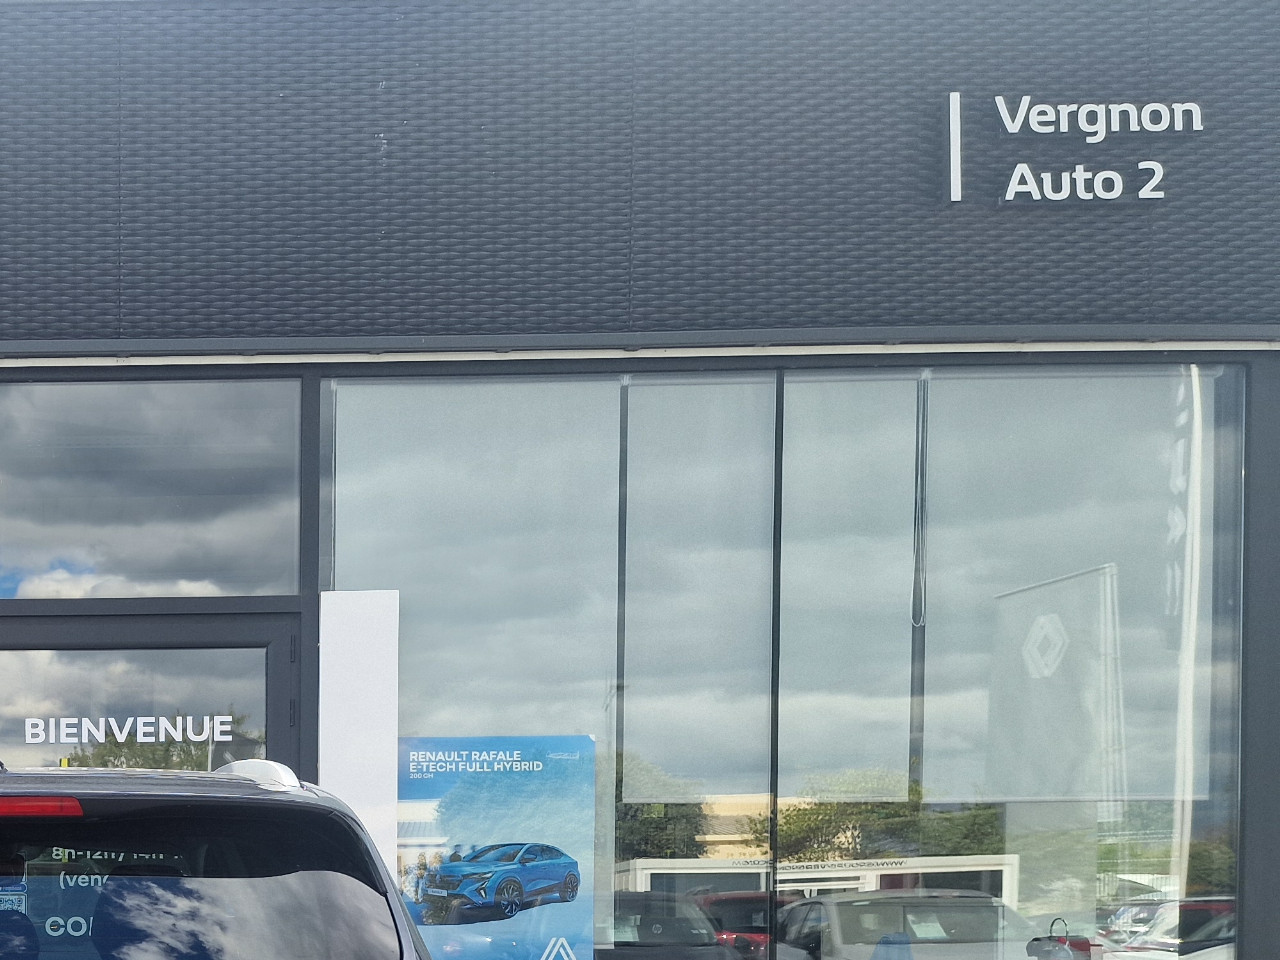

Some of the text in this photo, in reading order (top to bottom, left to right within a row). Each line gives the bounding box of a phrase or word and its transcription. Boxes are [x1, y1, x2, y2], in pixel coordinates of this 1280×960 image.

[994, 95, 1204, 144] Vergnon
[1004, 160, 1165, 201] Auto 2
[24, 715, 233, 745] BIENVENUE
[409, 751, 521, 761] RENAULT RAFALE
[409, 761, 543, 772] E-TECH FULL HYBRID
[45, 916, 94, 937] CO
